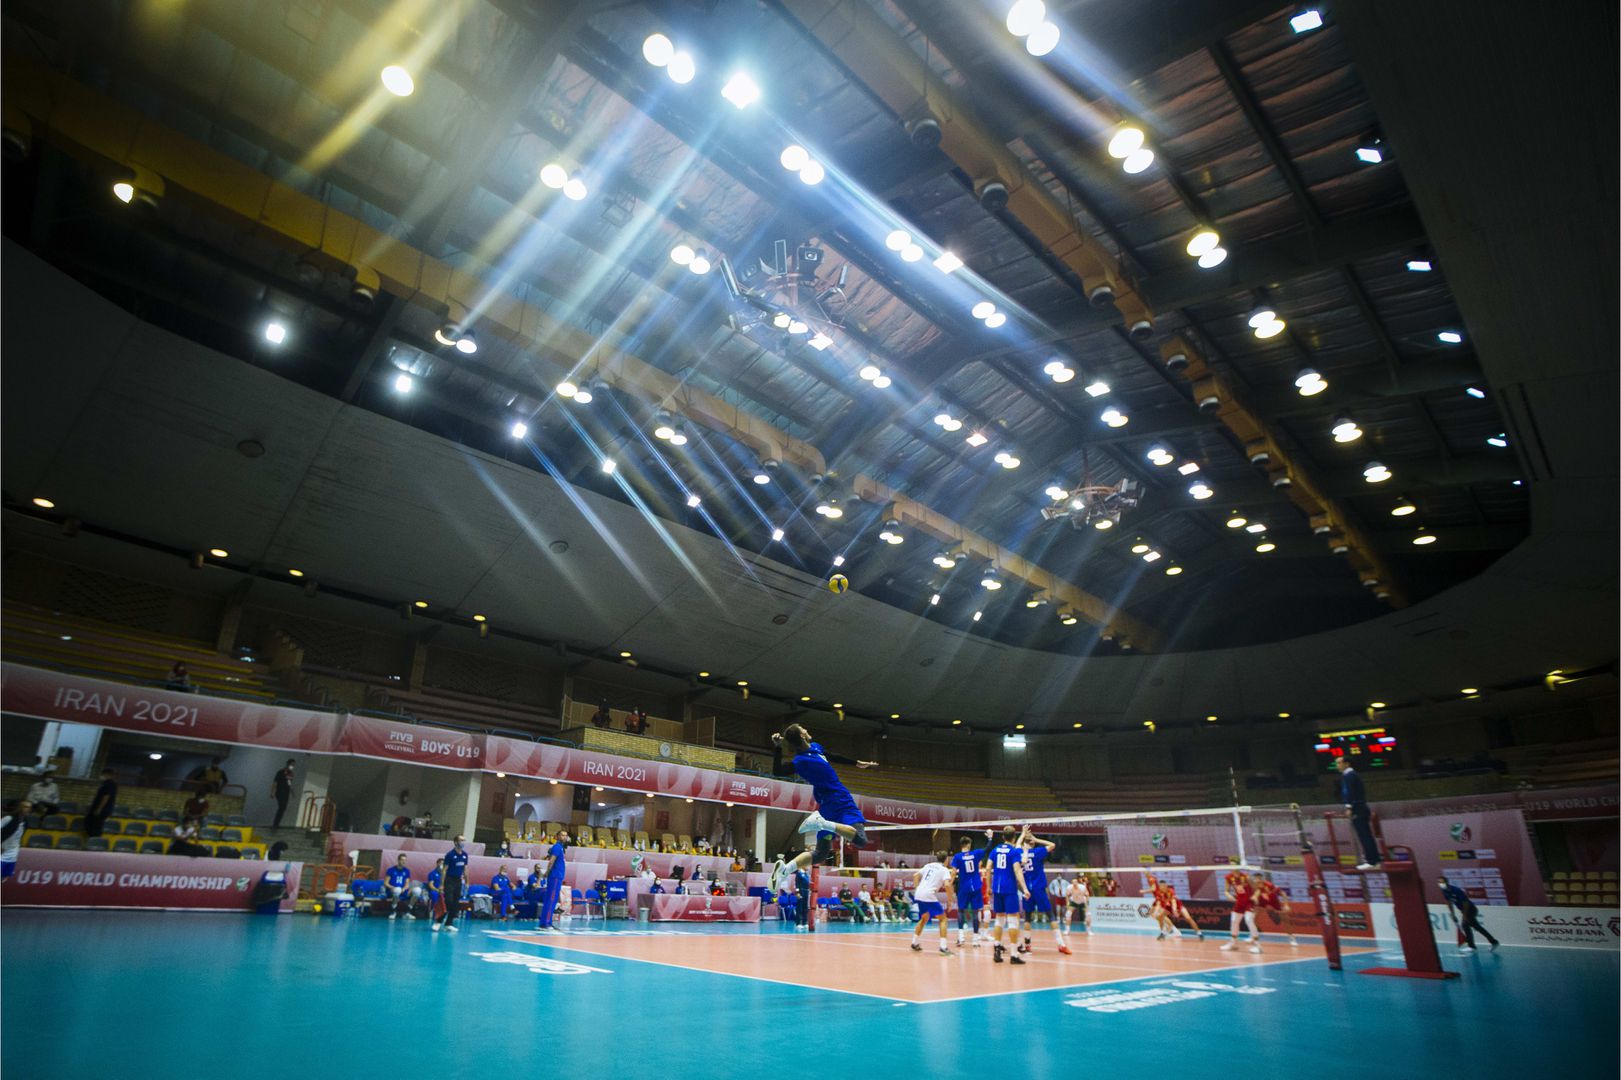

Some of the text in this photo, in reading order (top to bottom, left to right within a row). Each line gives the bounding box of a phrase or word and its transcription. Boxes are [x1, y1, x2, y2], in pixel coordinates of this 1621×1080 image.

[53, 687, 199, 727] IRAN 2021
[457, 745, 481, 759] U19
[583, 760, 646, 782] IRAN 2021
[1551, 798, 1598, 809] WORLD
[875, 804, 917, 820] IRAN 2021
[965, 860, 976, 873] 10
[996, 853, 1007, 869] 18
[17, 870, 233, 891] U19 WORLD CHAMPIONSHIP
[1529, 927, 1606, 938] TOURISM BANK
